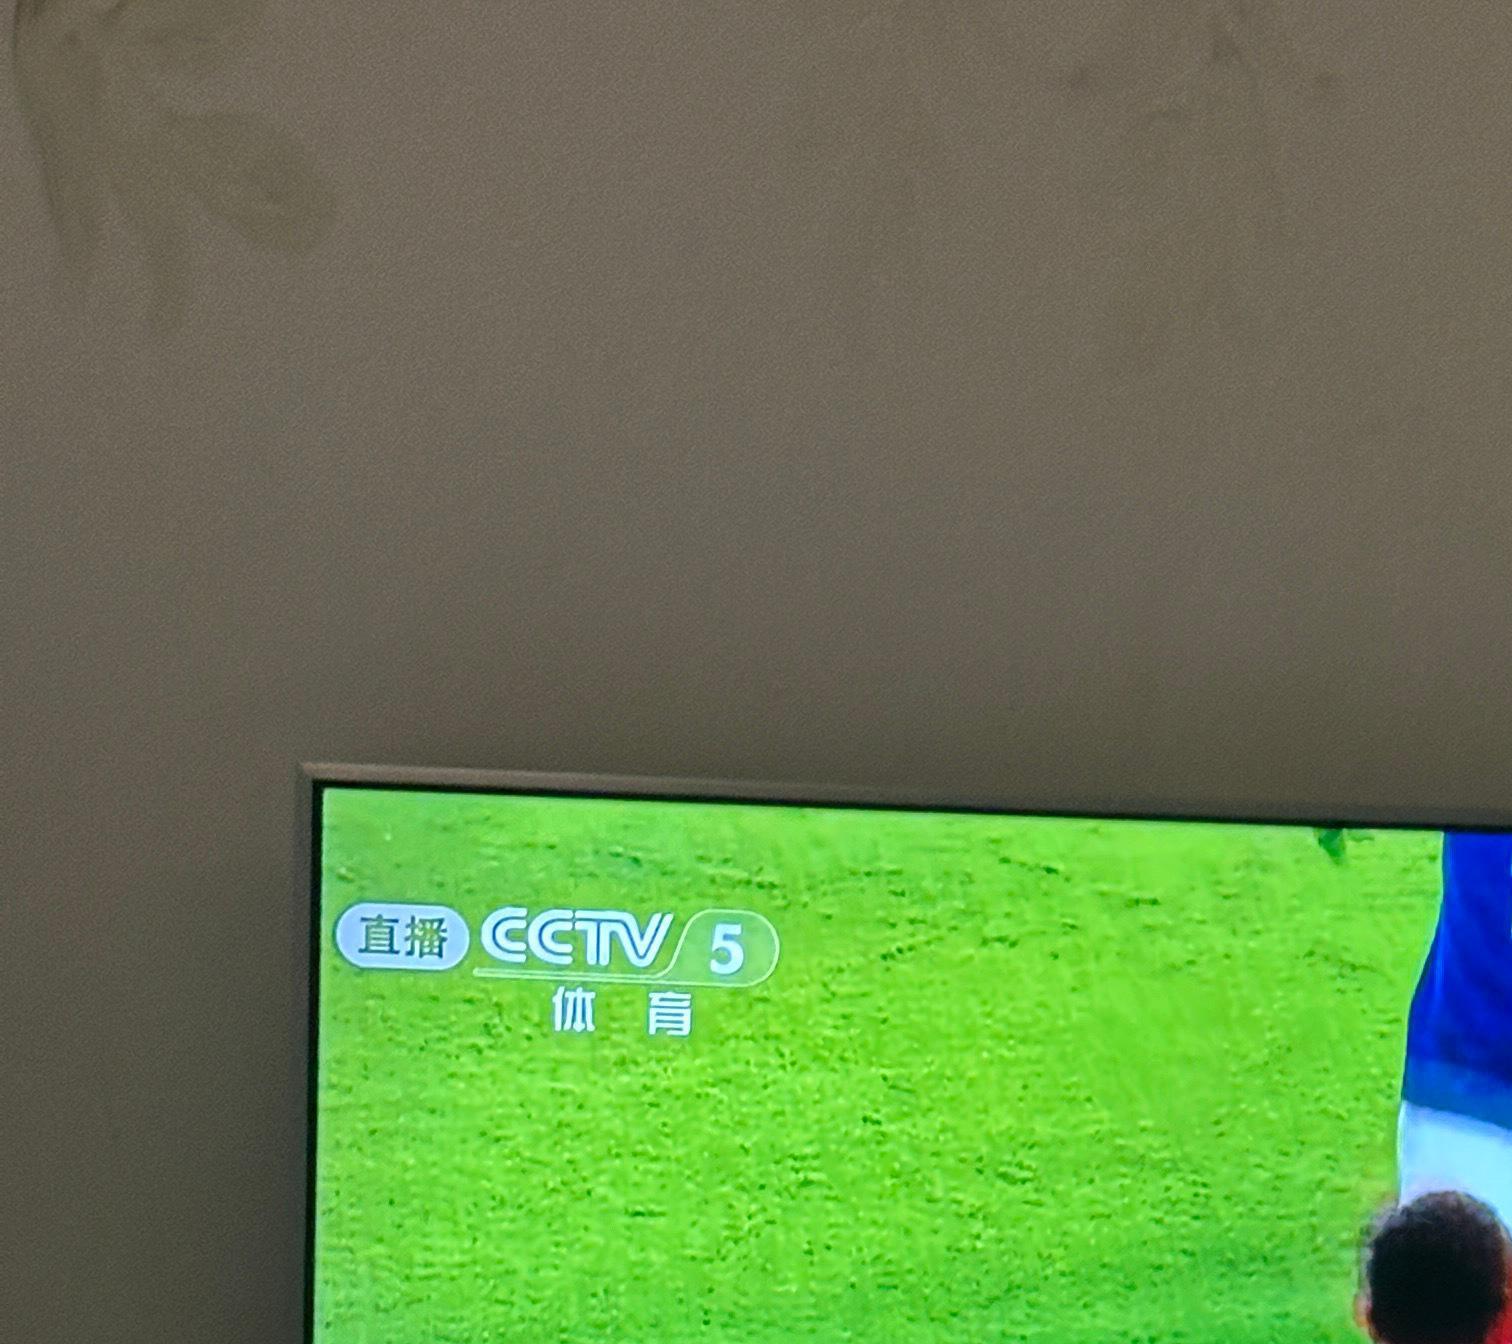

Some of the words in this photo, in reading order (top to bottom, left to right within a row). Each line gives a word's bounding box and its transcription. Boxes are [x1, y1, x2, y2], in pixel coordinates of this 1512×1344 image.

[357, 914, 448, 959] 直播
[480, 906, 674, 968] CCTV
[709, 923, 745, 976] 5
[552, 986, 692, 1037] 体育
